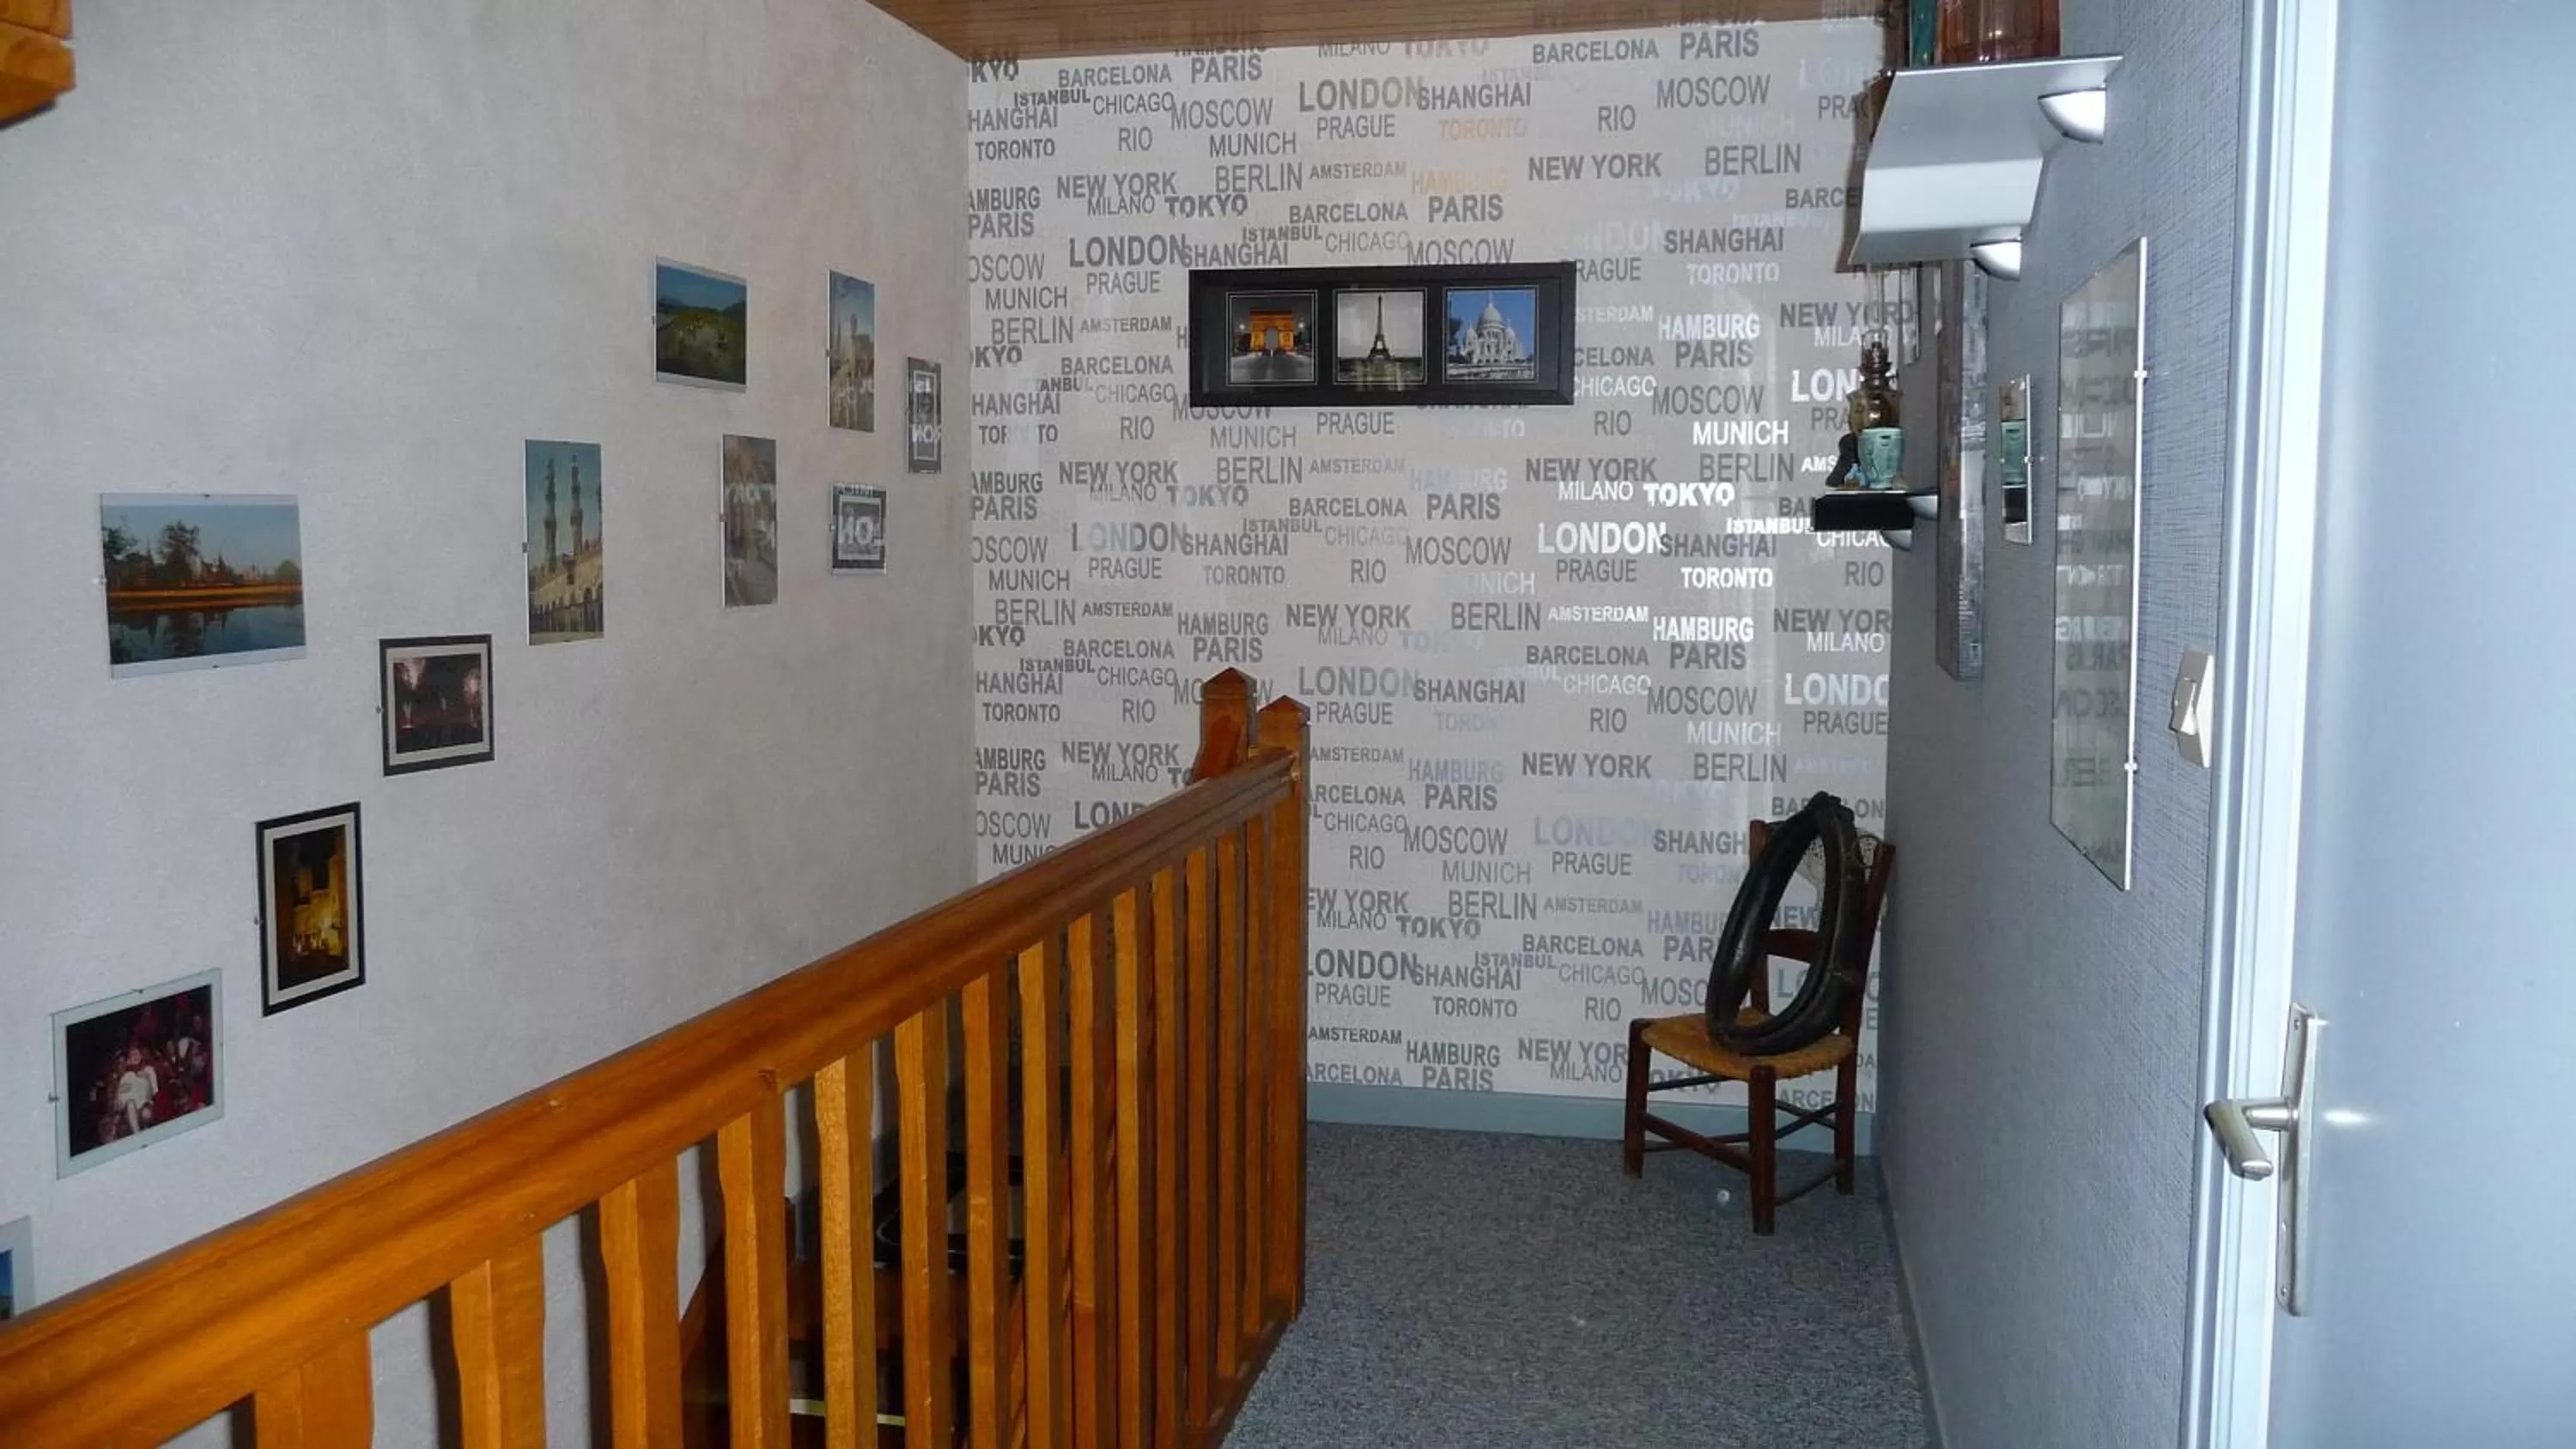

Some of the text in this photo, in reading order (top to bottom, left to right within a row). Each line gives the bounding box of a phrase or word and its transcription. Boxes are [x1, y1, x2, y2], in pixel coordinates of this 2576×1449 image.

[1533, 39, 1659, 64] BARCELONA
[1680, 29, 1759, 60] PARIS
[1059, 64, 1171, 88] BARCELONA
[1192, 55, 1262, 83] PARIS
[1014, 89, 1091, 107] ISTANBUL
[1094, 93, 1174, 115] CHICAGO
[1299, 77, 1422, 112] LONDON
[1417, 83, 1531, 112] SHANGHAI
[1657, 75, 1771, 109] MOSCOW
[969, 106, 1058, 131] HANGHAI
[1171, 98, 1273, 130] MOSCOW
[1599, 105, 1637, 131] RIO
[1316, 115, 1395, 139] PRAGUE
[1440, 118, 1527, 140] TORONTO
[976, 138, 1055, 161] TORONTO
[1119, 127, 1152, 152] RIO
[1210, 132, 1297, 157] MUNICH
[1309, 161, 1406, 179] AMSTERDAM
[1528, 153, 1662, 181] NEW YORK
[1705, 144, 1801, 176] BERLIN
[1057, 173, 1177, 198] NEW YORK
[1216, 163, 1303, 194] BERLIN
[1088, 195, 1155, 216] MILANO
[1165, 193, 1248, 218] TOKYO
[1429, 195, 1504, 222] PARIS
[1785, 188, 1860, 209] BARCE
[968, 211, 1035, 240] PARIS
[1290, 203, 1407, 224] BARCELONA
[1242, 226, 1322, 244] ISTANBUL
[1325, 230, 1409, 253] CHICAGO
[1665, 227, 1783, 254] SHANGHAI
[1069, 233, 1189, 268] LONDON
[1182, 243, 1289, 268] SHANGHAI
[1407, 237, 1515, 265] MOSCOW
[1087, 270, 1161, 294] PRAGUE
[1577, 258, 1641, 282] RAGUE
[1686, 263, 1779, 286] TORONTO
[986, 288, 1067, 310] MUNICH
[1080, 316, 1171, 333] AMSTERDAM
[1658, 313, 1760, 341] HAMBURG
[1780, 302, 1838, 328] NEW
[992, 316, 1072, 344] BERLIN
[1061, 355, 1173, 376] BARCELONA
[1575, 346, 1654, 367] CELONA
[1676, 342, 1753, 368] PARIS
[972, 391, 1060, 415] HANGHAI
[1096, 383, 1175, 403] CHICAGO
[1652, 385, 1764, 416] MOSCOW
[1121, 416, 1154, 440] RIO
[1316, 412, 1394, 435] PRAGUE
[1595, 409, 1631, 436] RIO
[1693, 420, 1789, 446] MUNICH
[1211, 425, 1296, 448] MUNICH
[1059, 460, 1177, 485] NEW YORK
[1218, 457, 1303, 484] BERLIN
[1309, 458, 1405, 475] AMSTERDAM
[1527, 458, 1657, 484] NEW YORK
[1700, 452, 1795, 483] BERLIN
[1090, 484, 1157, 502] MILANO
[1167, 485, 1249, 507] TOKYO
[1558, 482, 1633, 502] MILANO
[1643, 482, 1735, 506] TOKYO
[1290, 498, 1406, 517] BARCELONA
[1426, 493, 1501, 520] PARIS
[1242, 518, 1322, 533] ISTANBUL
[1325, 525, 1406, 546] CHICAGO
[1182, 533, 1289, 556] SHANGHAI
[1538, 522, 1667, 554] LONDON
[1660, 534, 1777, 558] SHANGHAI
[1406, 536, 1511, 566] MOSCOW
[988, 569, 1070, 591] MUNICH
[1089, 557, 1162, 579] PRAGUE
[1205, 566, 1285, 585] TORONTO
[1351, 559, 1386, 584] RIO
[1557, 559, 1637, 583] PRAGUE
[1681, 567, 1773, 588] TORONTO
[1845, 561, 1884, 586] RIO
[995, 599, 1075, 626] BERLIN
[1082, 602, 1172, 617] AMSTERDAM
[1288, 604, 1411, 628] NEW YORK
[1451, 602, 1540, 631] BERLIN
[1547, 605, 1649, 622] AMSTERDAM
[1773, 609, 1892, 633] NEW YOR
[1179, 613, 1268, 635] HAMBURG
[1654, 616, 1753, 642] HAMBURG
[1318, 627, 1388, 646] MILANO
[1807, 633, 1884, 653] MILANO
[1064, 640, 1174, 659] BARCELONA
[1193, 637, 1262, 663] PARIS
[1527, 645, 1649, 666] BARCELONA
[1670, 644, 1746, 670] PARIS
[1019, 658, 1095, 674] ISTANBUL
[1097, 666, 1176, 687] CHICAGO
[977, 671, 1063, 695] HANGHAI
[1298, 666, 1420, 696] LONDON
[1413, 679, 1526, 704] SHANGHAI
[1564, 673, 1651, 695] CHICAGO
[1785, 672, 1889, 706] LONDO
[983, 702, 1060, 723] TORONTO
[1122, 699, 1155, 723] RIO
[1647, 686, 1757, 715] MOSCOW
[1316, 701, 1394, 725] PRAGUE
[1589, 708, 1626, 733] RIO
[1804, 711, 1888, 735] PRAGUE
[1687, 720, 1782, 747] MUNICH
[1062, 742, 1180, 766] NEW YORK
[1522, 752, 1651, 779] NEW YORK
[1091, 764, 1157, 784] MILANO
[1409, 759, 1505, 784] HAMBURG
[1694, 754, 1787, 782] BERLIN
[1425, 784, 1498, 811] PARIS
[1324, 813, 1406, 834] CHICAGO
[1404, 826, 1508, 856] MOSCOW
[1654, 828, 1748, 855] SHANGH
[1349, 845, 1385, 870] RIO
[1552, 852, 1632, 876] PRAGUE
[1443, 860, 1531, 885] MUNICH
[1345, 890, 1408, 914] YORK
[1449, 890, 1537, 919] BERLIN
[1544, 896, 1643, 913] AMSTERDAM
[1317, 911, 1387, 931] MILANO
[1397, 915, 1480, 939] TOKYO
[1523, 934, 1643, 958] BARCELONA
[1309, 947, 1418, 981] ONDON
[1474, 951, 1556, 970] ISTANBUL
[1414, 962, 1521, 991] SHANGHAI
[1559, 963, 1645, 985] CHICAGO
[1315, 982, 1390, 1007] PRAGUE
[1433, 996, 1517, 1018] TORONTO
[1585, 997, 1621, 1022] RIO
[1309, 1027, 1401, 1046] AMSTERDAM
[1406, 1040, 1500, 1068] HAMBURG
[1518, 1038, 1571, 1063] NEW
[1422, 1065, 1494, 1091] PARIS
[1551, 1062, 1621, 1084] MILANO
